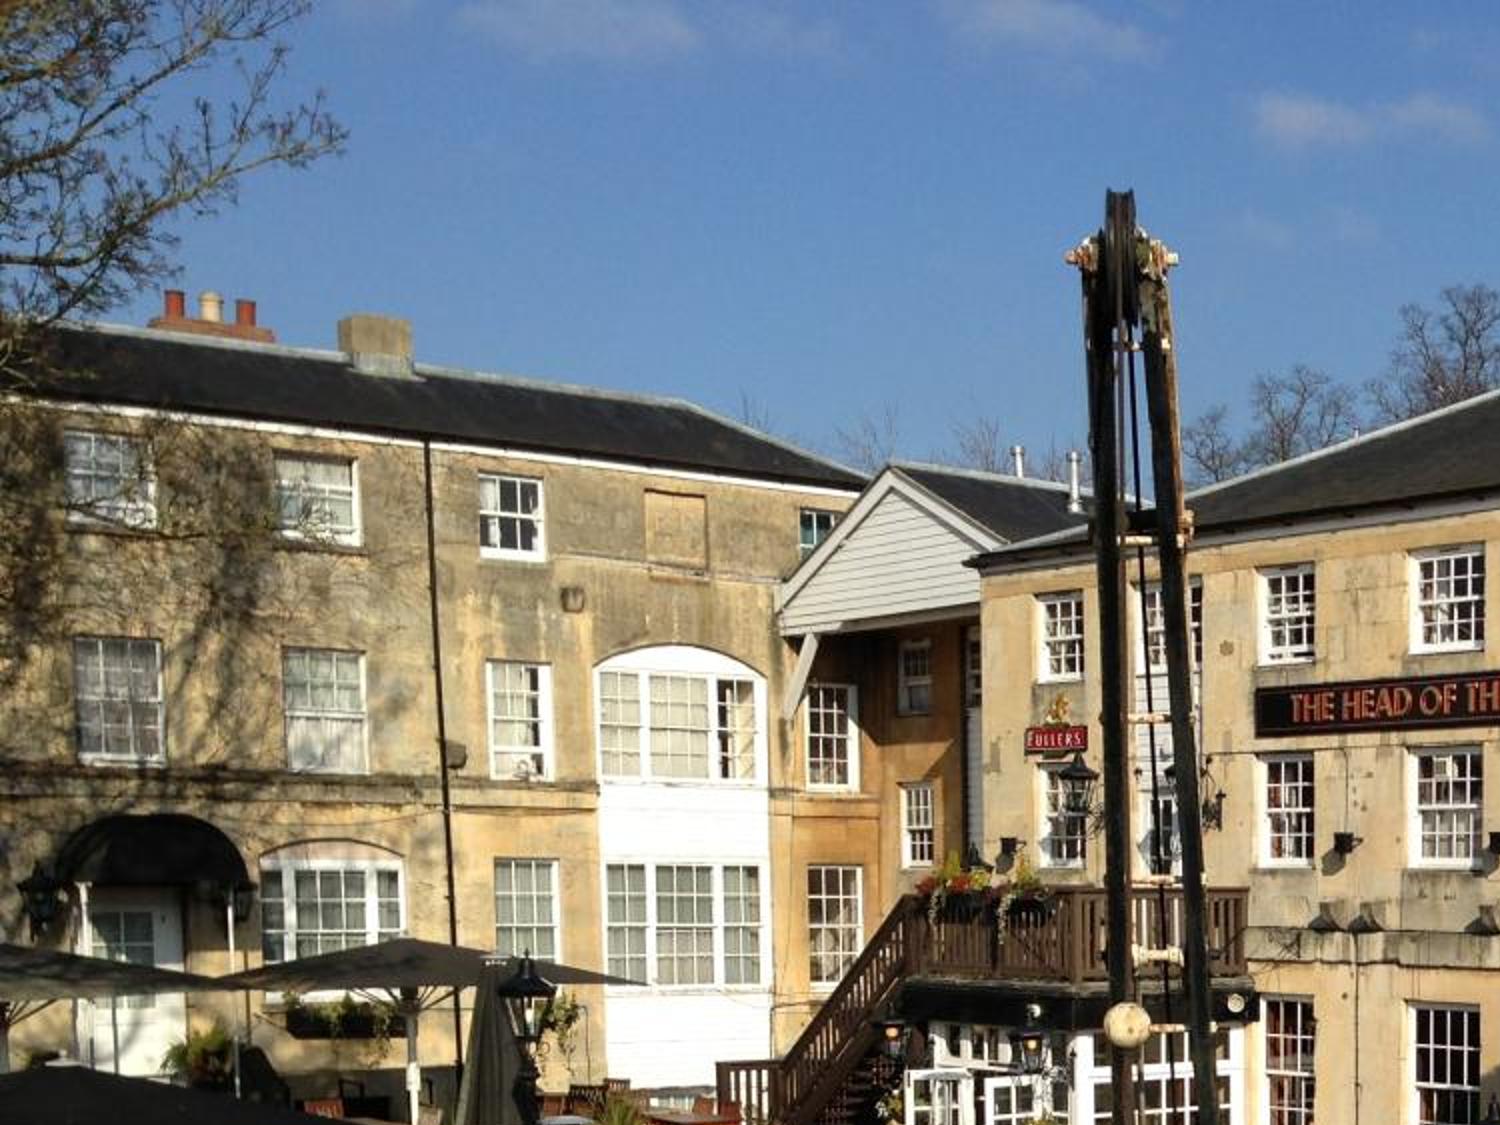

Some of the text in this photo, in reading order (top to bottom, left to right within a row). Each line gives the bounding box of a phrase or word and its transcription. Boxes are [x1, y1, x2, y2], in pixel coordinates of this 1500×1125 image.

[1290, 691, 1335, 723] THE
[1341, 686, 1413, 721] HEAD
[1419, 683, 1457, 716] OF
